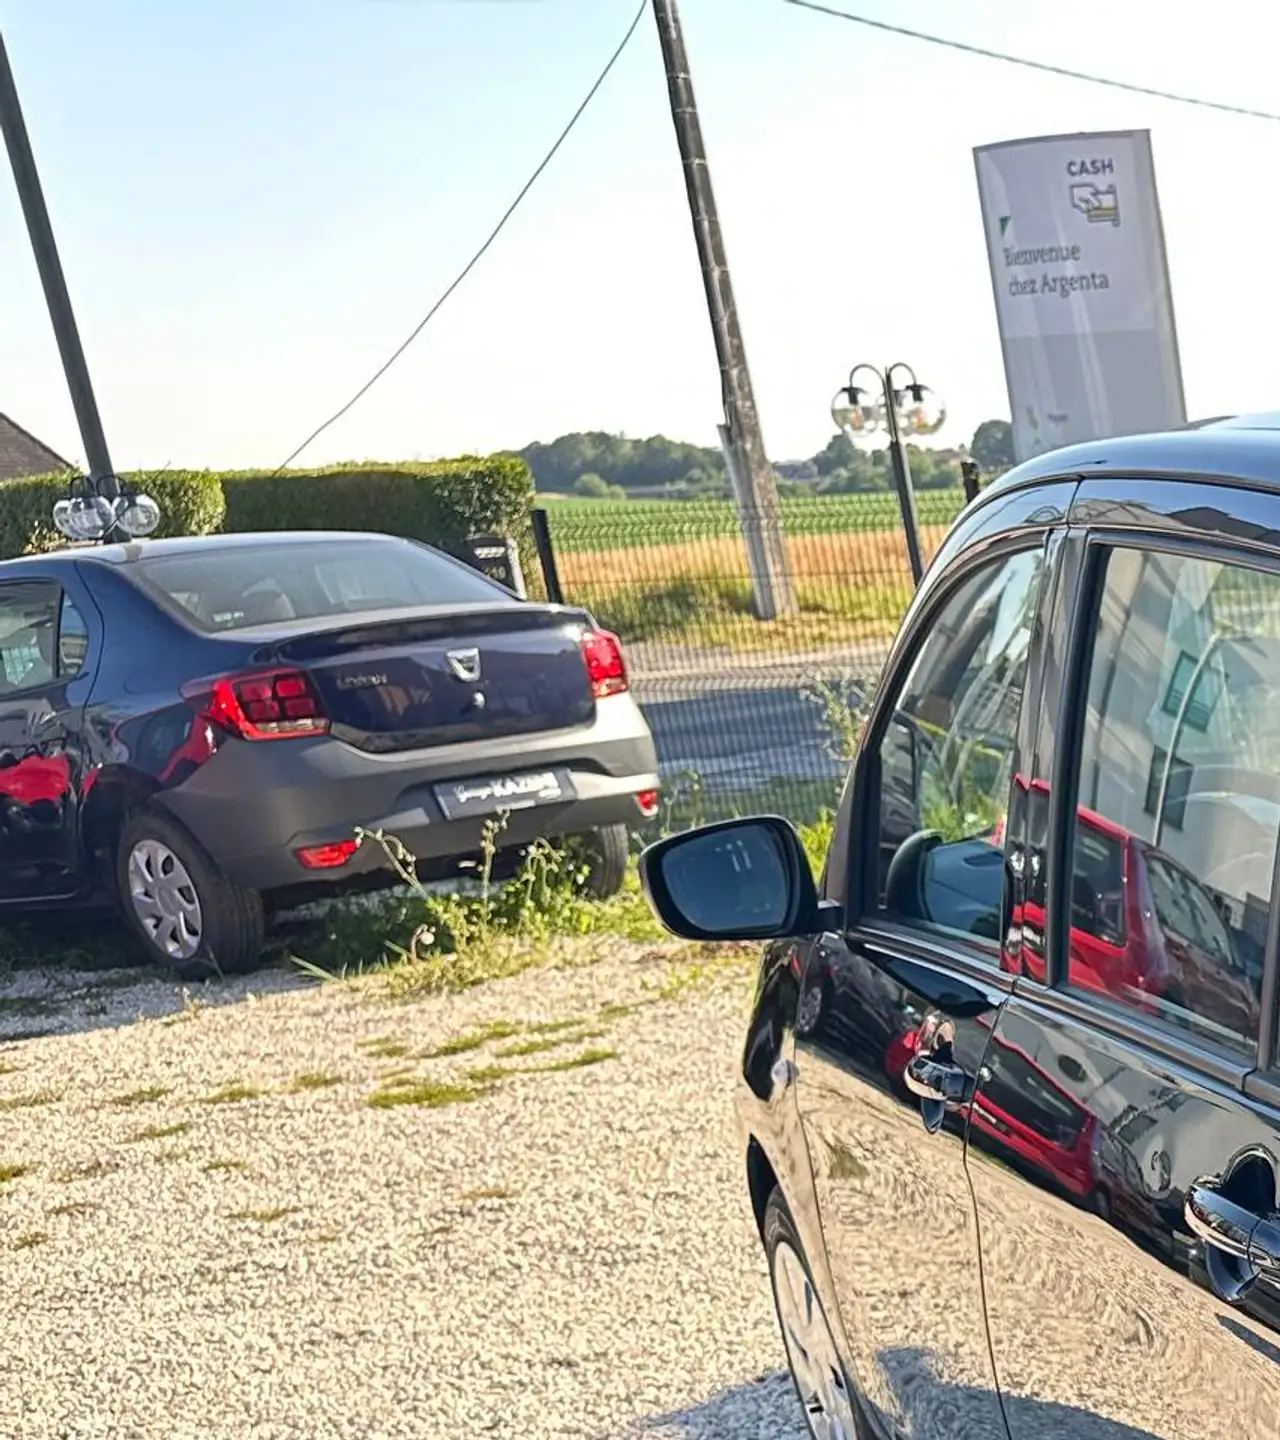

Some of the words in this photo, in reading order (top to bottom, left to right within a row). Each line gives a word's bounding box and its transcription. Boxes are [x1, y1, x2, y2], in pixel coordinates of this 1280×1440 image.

[1066, 159, 1114, 177] CASH
[1003, 243, 1081, 267] Bienvenue
[1009, 276, 1038, 296] chez
[1041, 271, 1110, 298] Argenta
